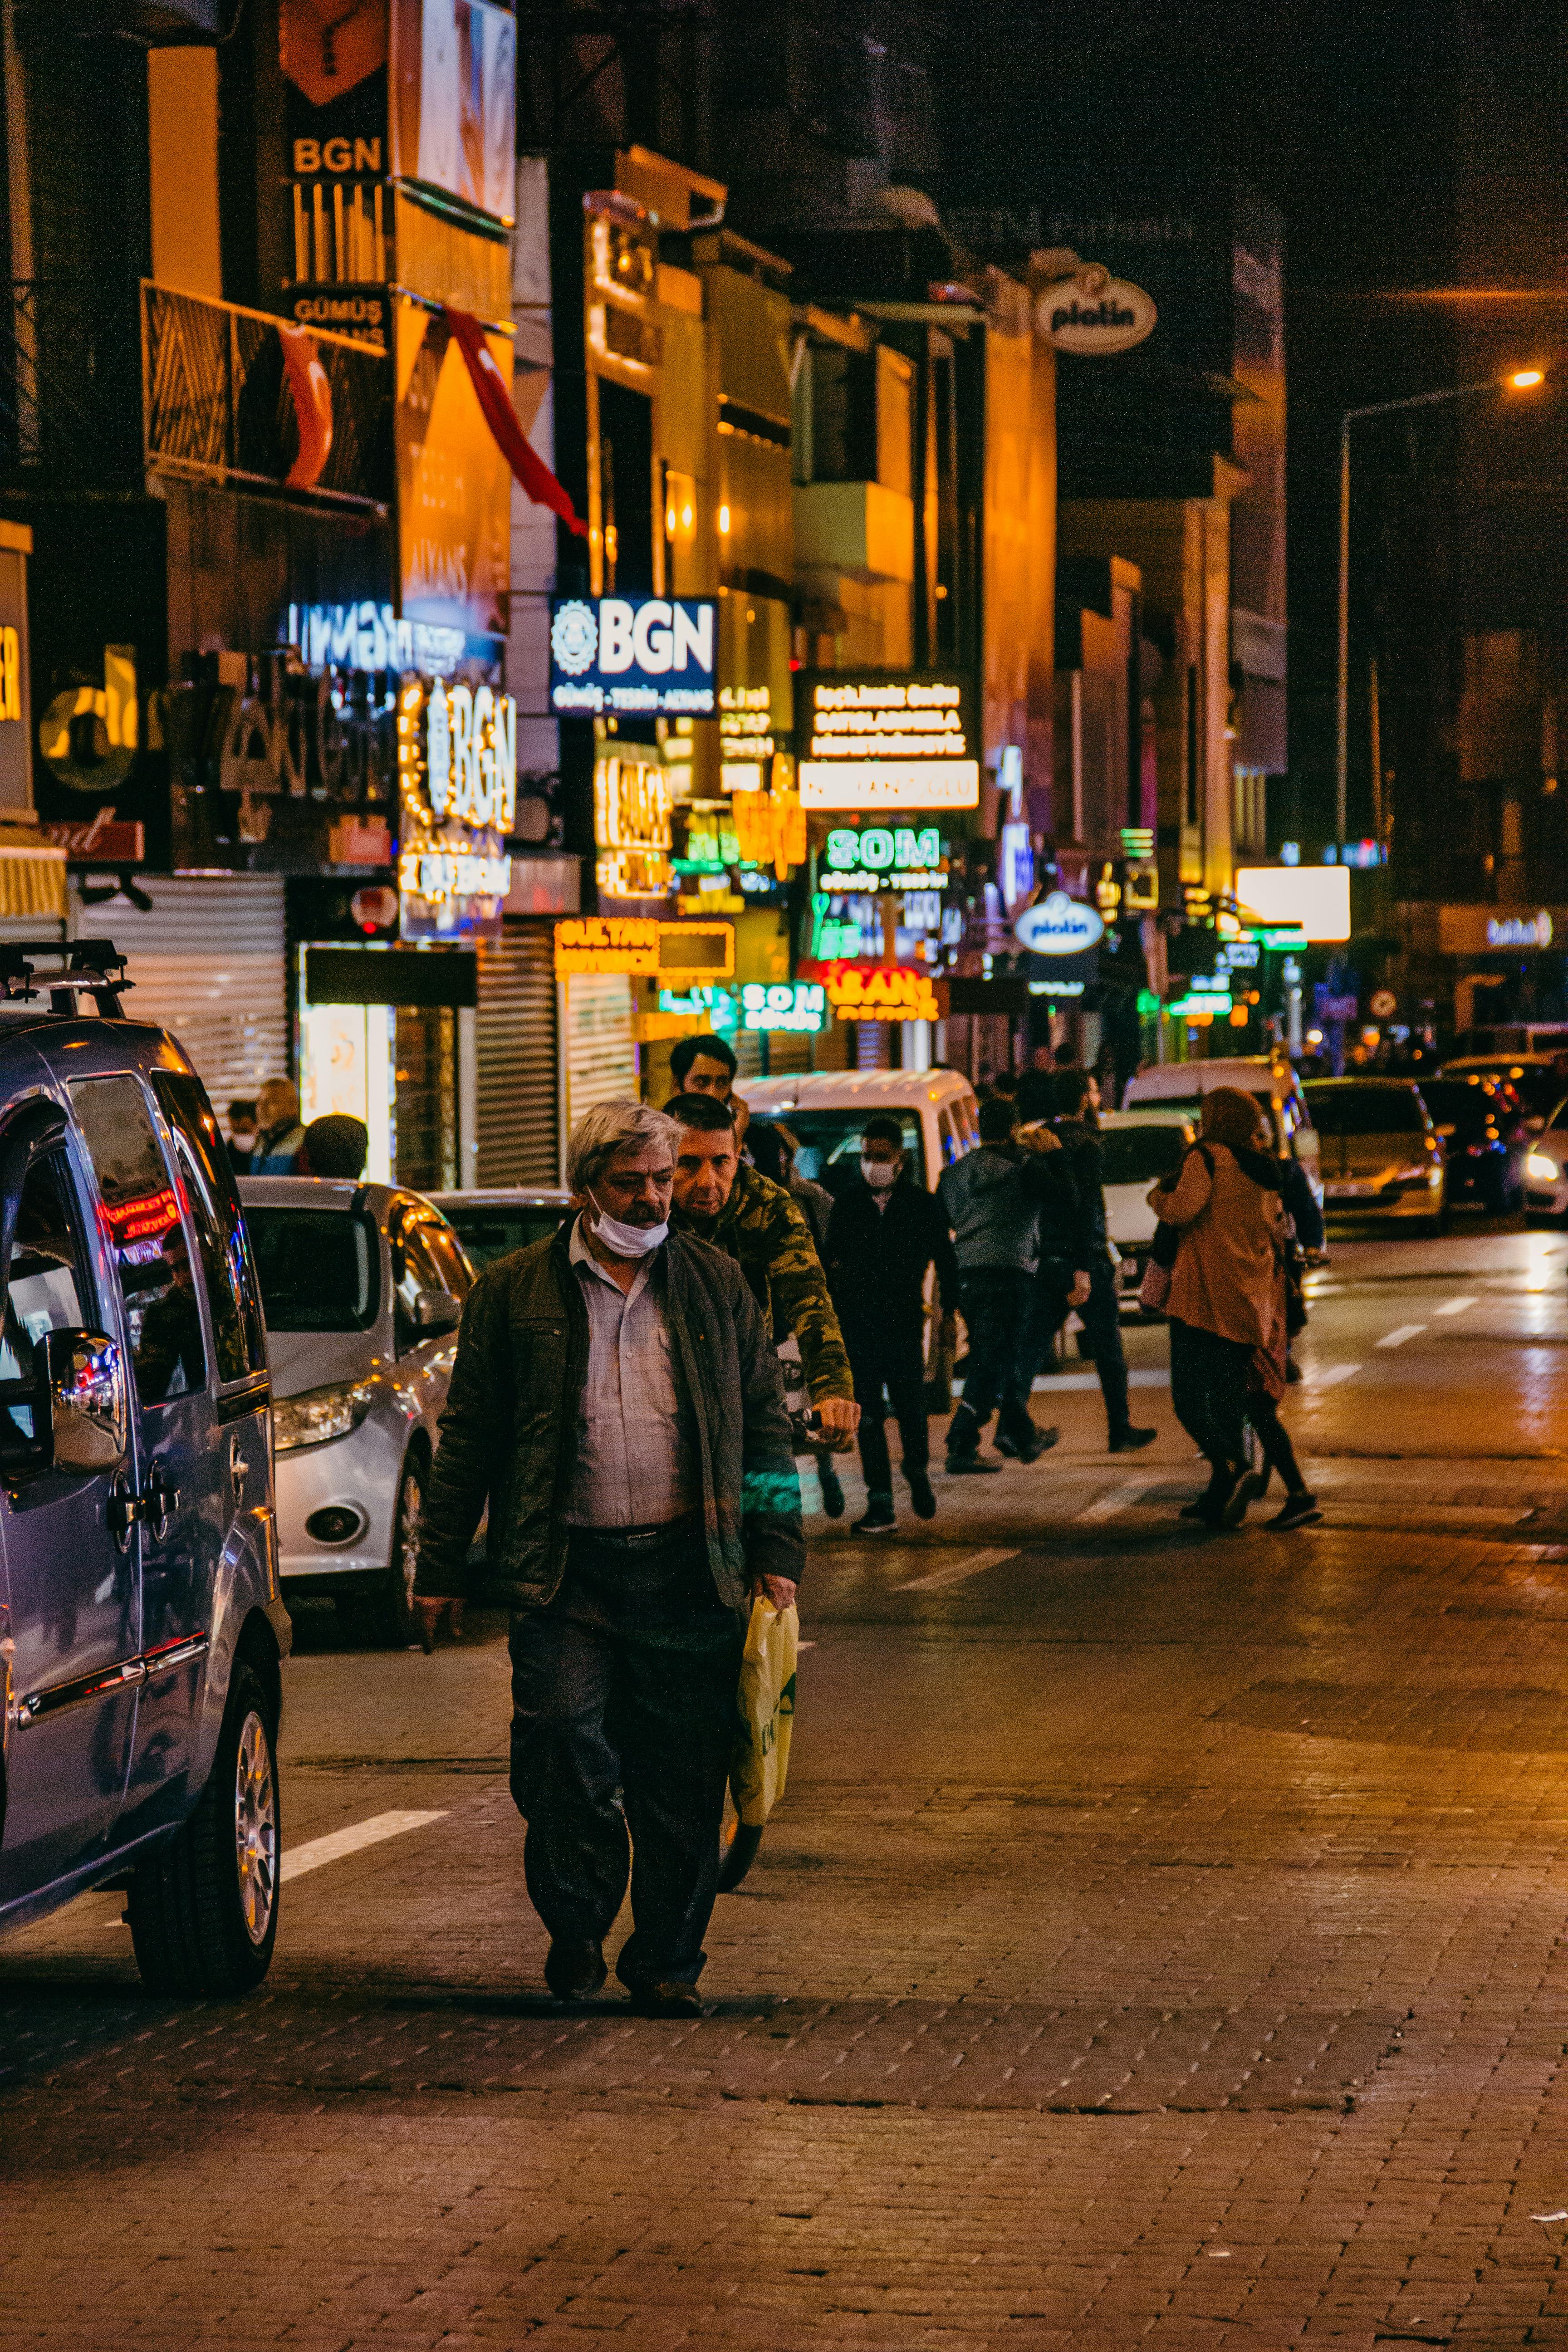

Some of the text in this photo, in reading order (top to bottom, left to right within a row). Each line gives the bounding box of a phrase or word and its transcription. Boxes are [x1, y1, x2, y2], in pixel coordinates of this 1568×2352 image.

[294, 137, 382, 173] BGN
[1051, 297, 1135, 333] platin
[599, 598, 713, 674] BGN
[828, 828, 940, 869] SOM
[1031, 918, 1088, 938] platin
[743, 984, 824, 1012] SOM
